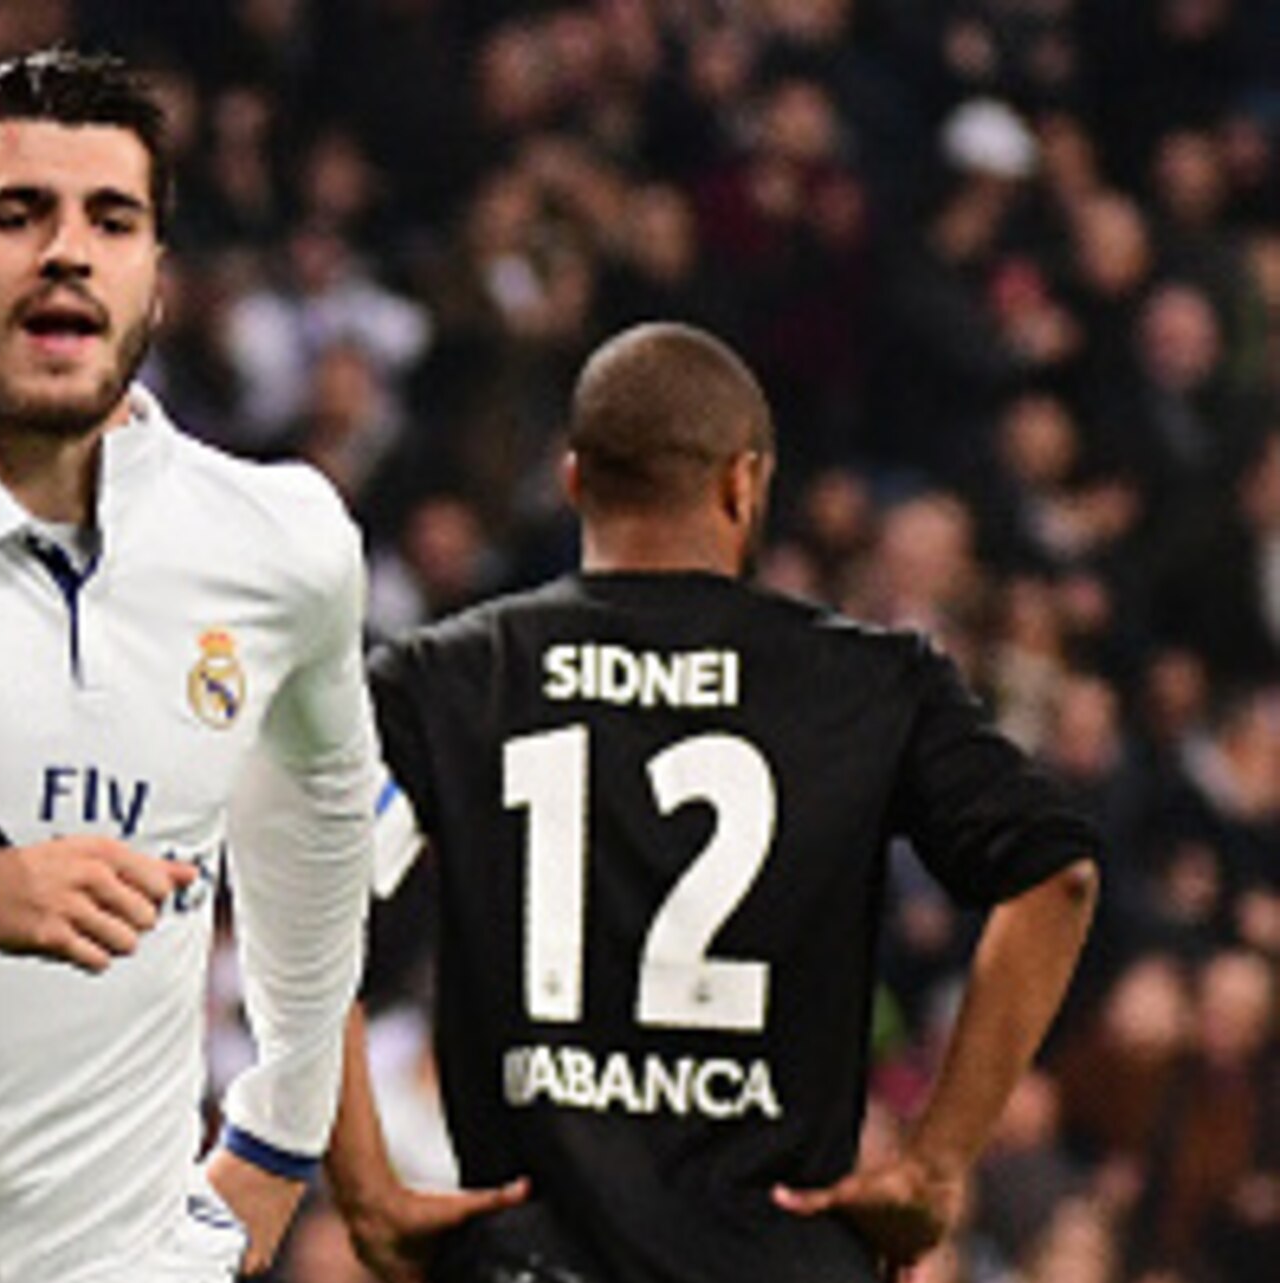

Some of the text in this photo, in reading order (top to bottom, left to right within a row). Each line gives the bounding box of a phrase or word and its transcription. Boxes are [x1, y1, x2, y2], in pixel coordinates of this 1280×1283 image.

[544, 644, 739, 707] SIDNEI
[40, 766, 150, 839] Fly
[502, 724, 778, 1032] 12
[522, 1045, 784, 1120] ABANCA
